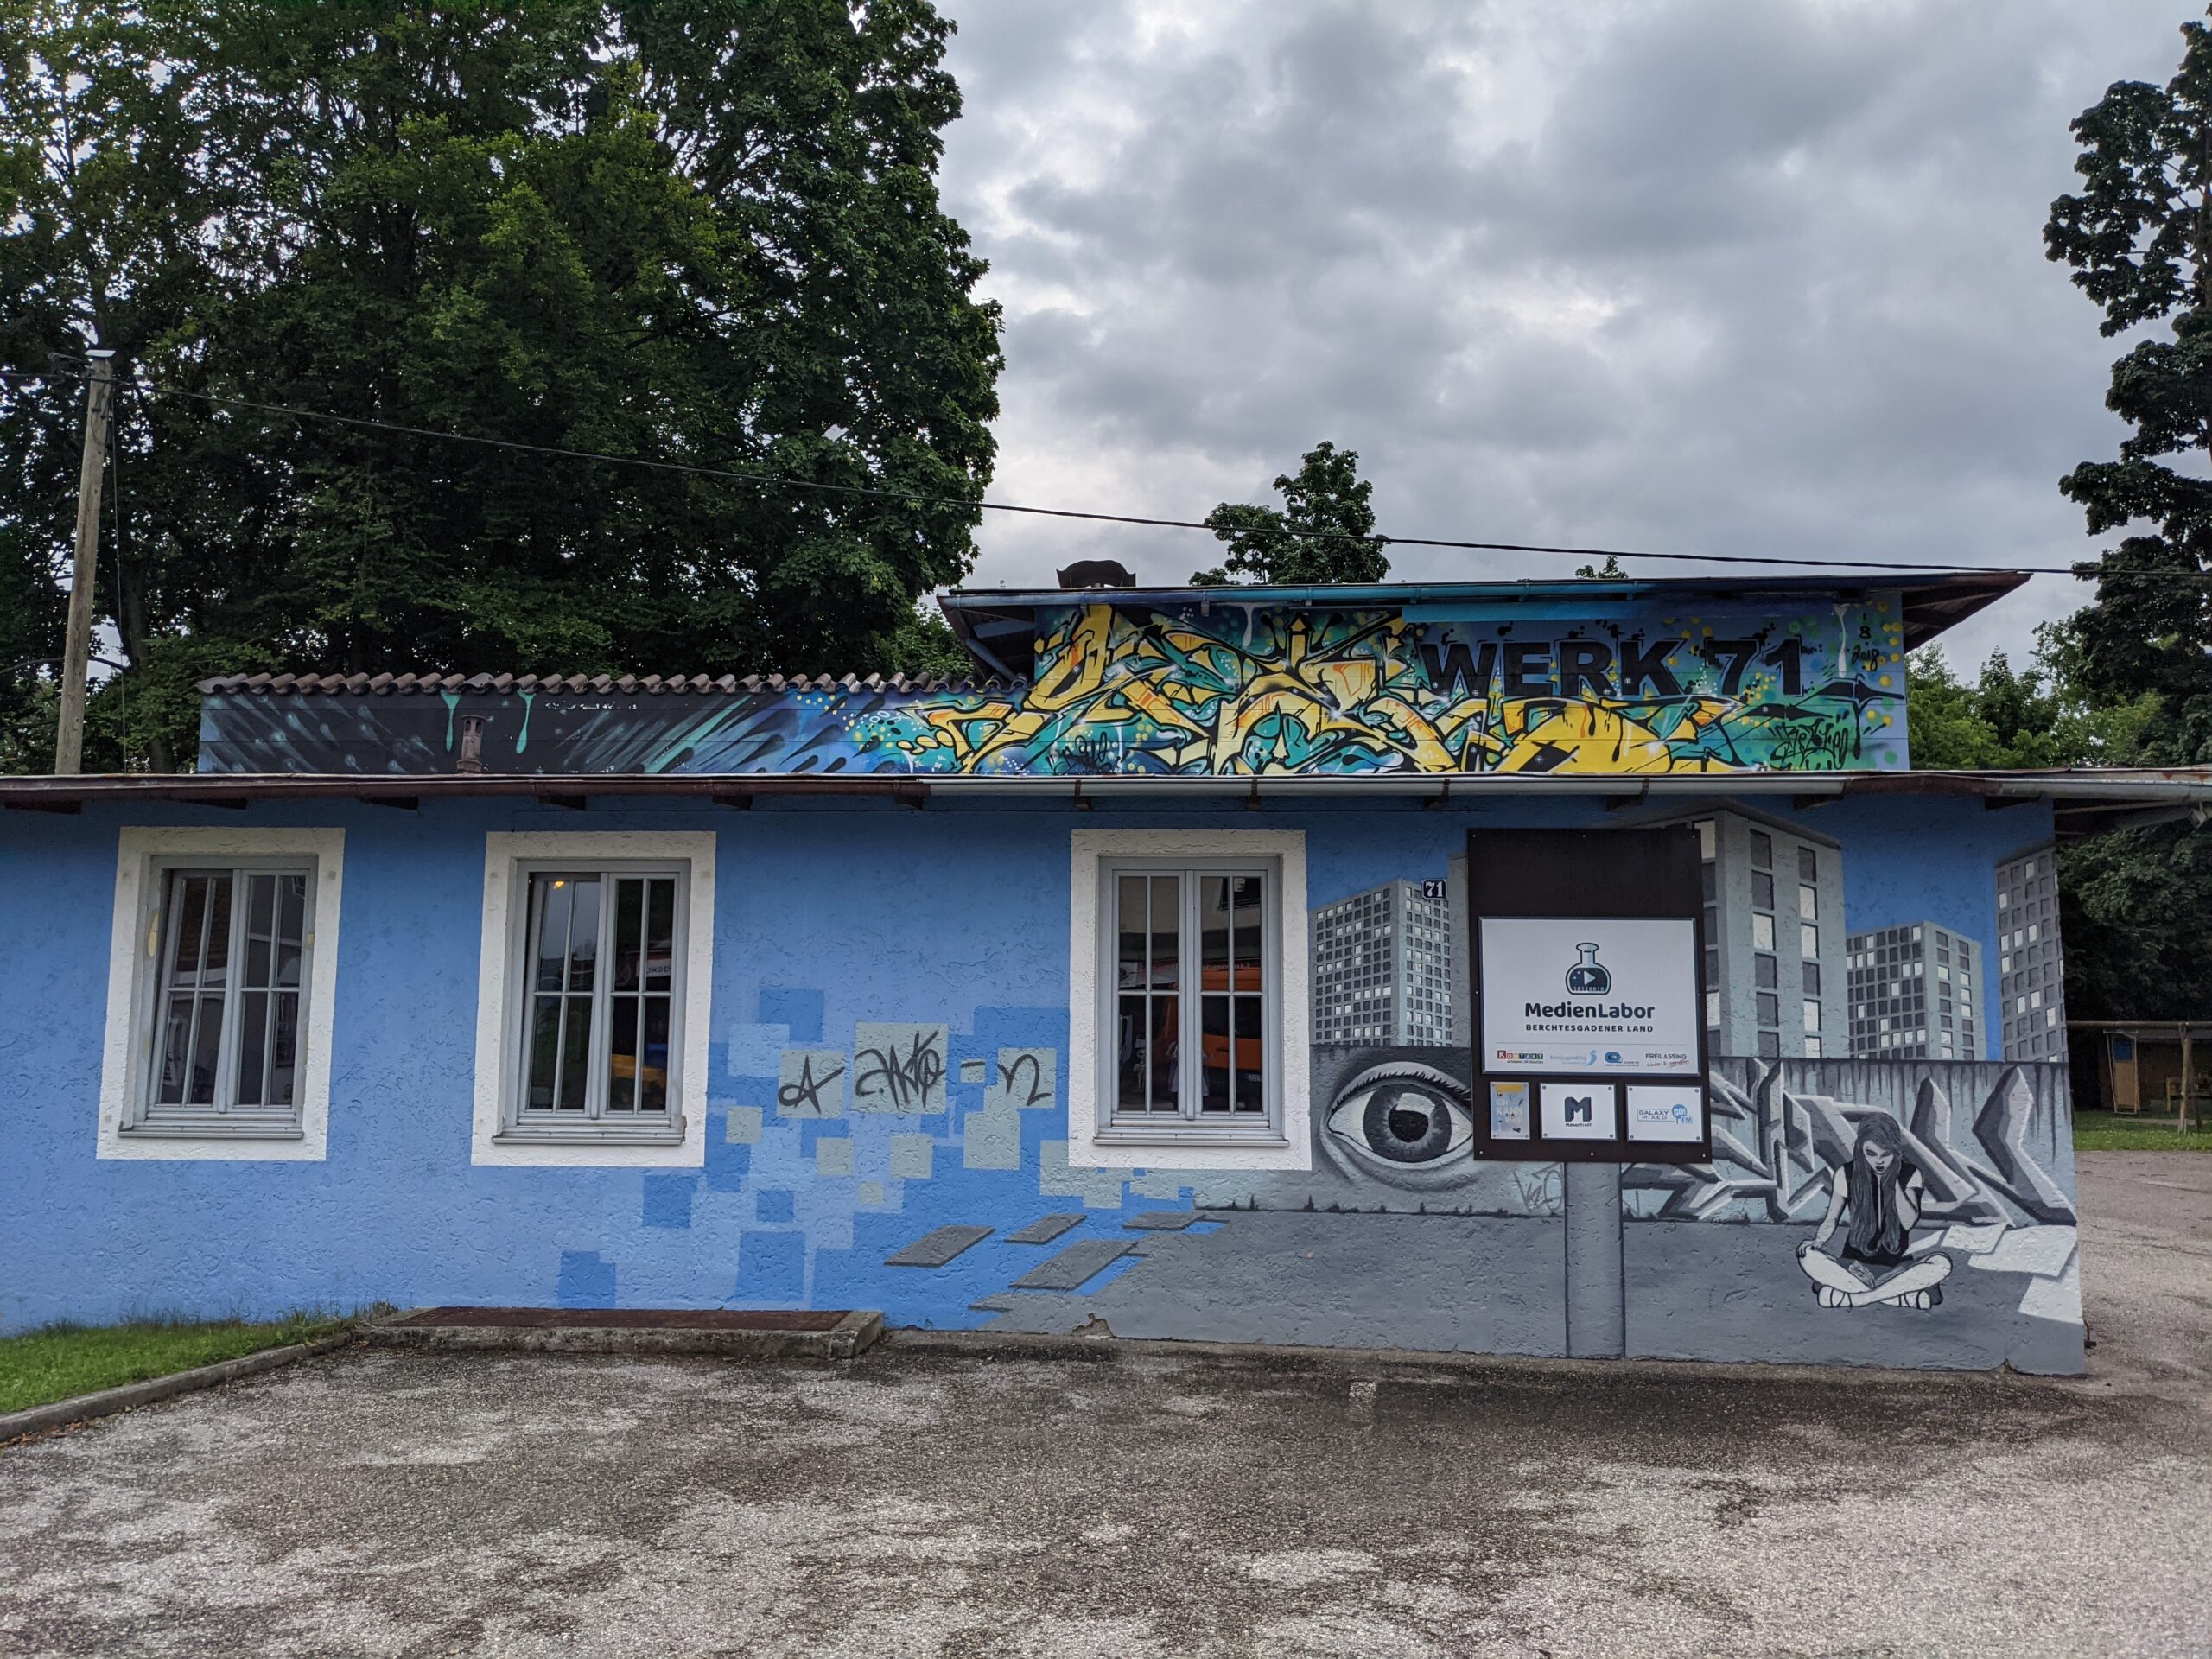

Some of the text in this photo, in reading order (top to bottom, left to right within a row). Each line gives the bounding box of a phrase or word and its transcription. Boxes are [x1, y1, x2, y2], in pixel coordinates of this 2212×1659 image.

[1420, 638, 1802, 696] WERK 71
[1425, 880, 1444, 897] 71
[1524, 1001, 1656, 1019] MedienLabor
[1525, 1024, 1624, 1033] BERCHTESGADENER
